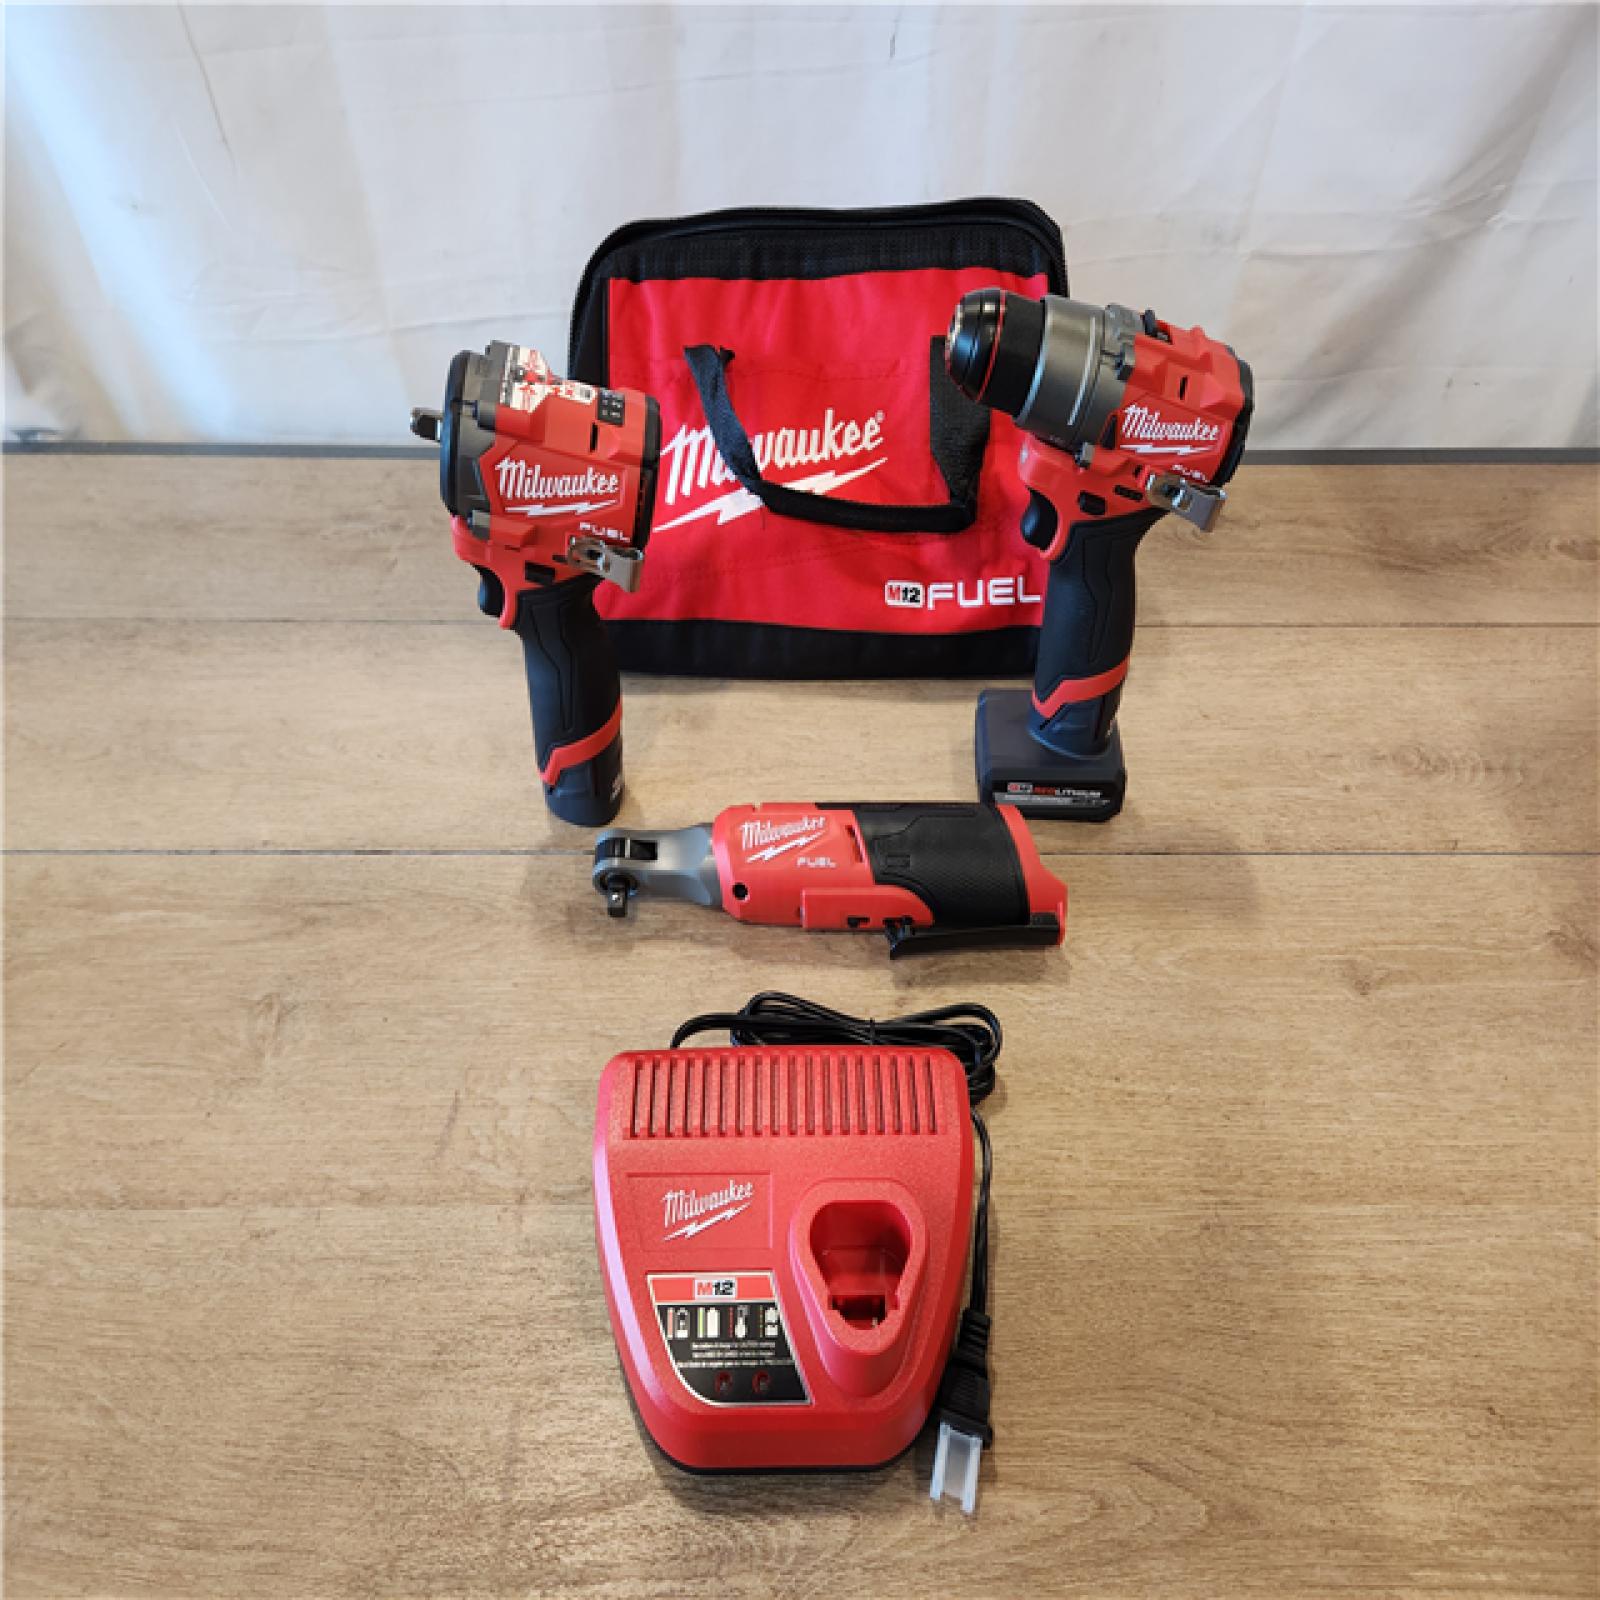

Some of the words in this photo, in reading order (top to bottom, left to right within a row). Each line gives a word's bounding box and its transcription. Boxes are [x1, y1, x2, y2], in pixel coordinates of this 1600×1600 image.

[1121, 403, 1220, 441] Milwaukee
[495, 456, 619, 500] Milwaukee
[579, 521, 631, 543] FUEL
[886, 583, 922, 604] M12
[927, 575, 1041, 611] FUEL
[740, 815, 826, 851] Milwaukee
[796, 856, 837, 868] FUEL
[661, 1179, 754, 1229] Milwaukee
[697, 1280, 735, 1296] M12
